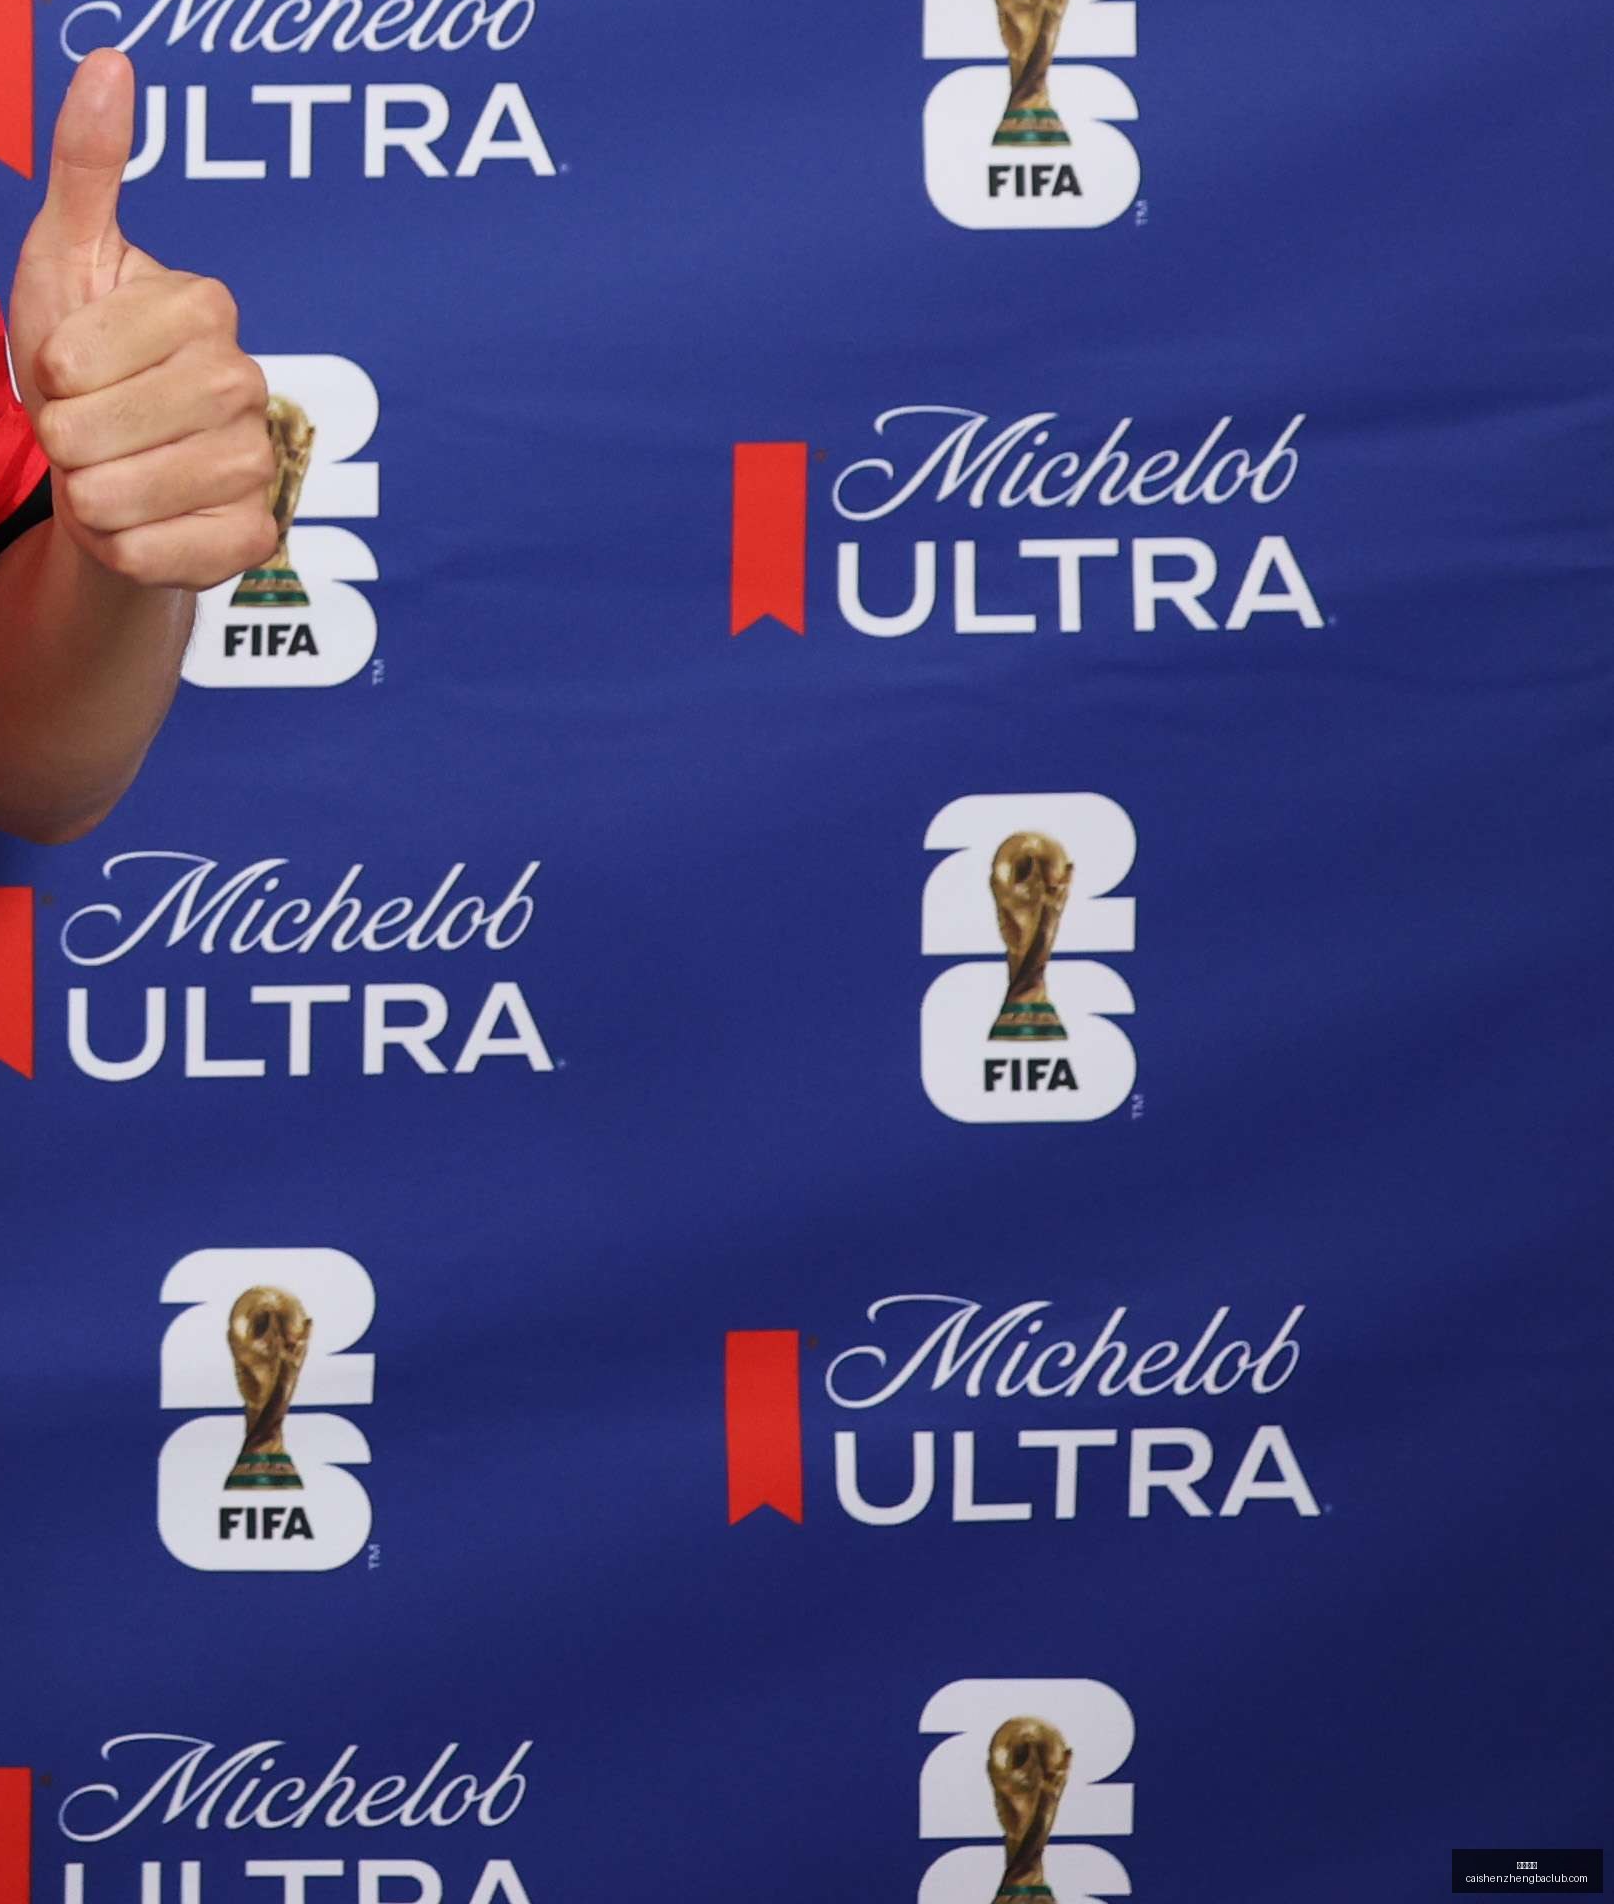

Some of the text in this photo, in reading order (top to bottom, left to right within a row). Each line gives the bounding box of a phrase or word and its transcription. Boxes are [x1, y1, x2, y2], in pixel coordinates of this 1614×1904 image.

[988, 164, 1082, 198] FIFA
[832, 405, 1306, 522] Michelob
[837, 535, 1325, 638] ULTRA
[224, 623, 319, 657] FIFA
[60, 850, 541, 967] Michelob
[67, 981, 554, 1082] ULTRA
[984, 1058, 1079, 1092] FIFA
[825, 1294, 1306, 1409] Michelob
[219, 1506, 314, 1540] FIFA
[834, 1425, 1321, 1526] ULTRA
[59, 1732, 533, 1842] Michelob
